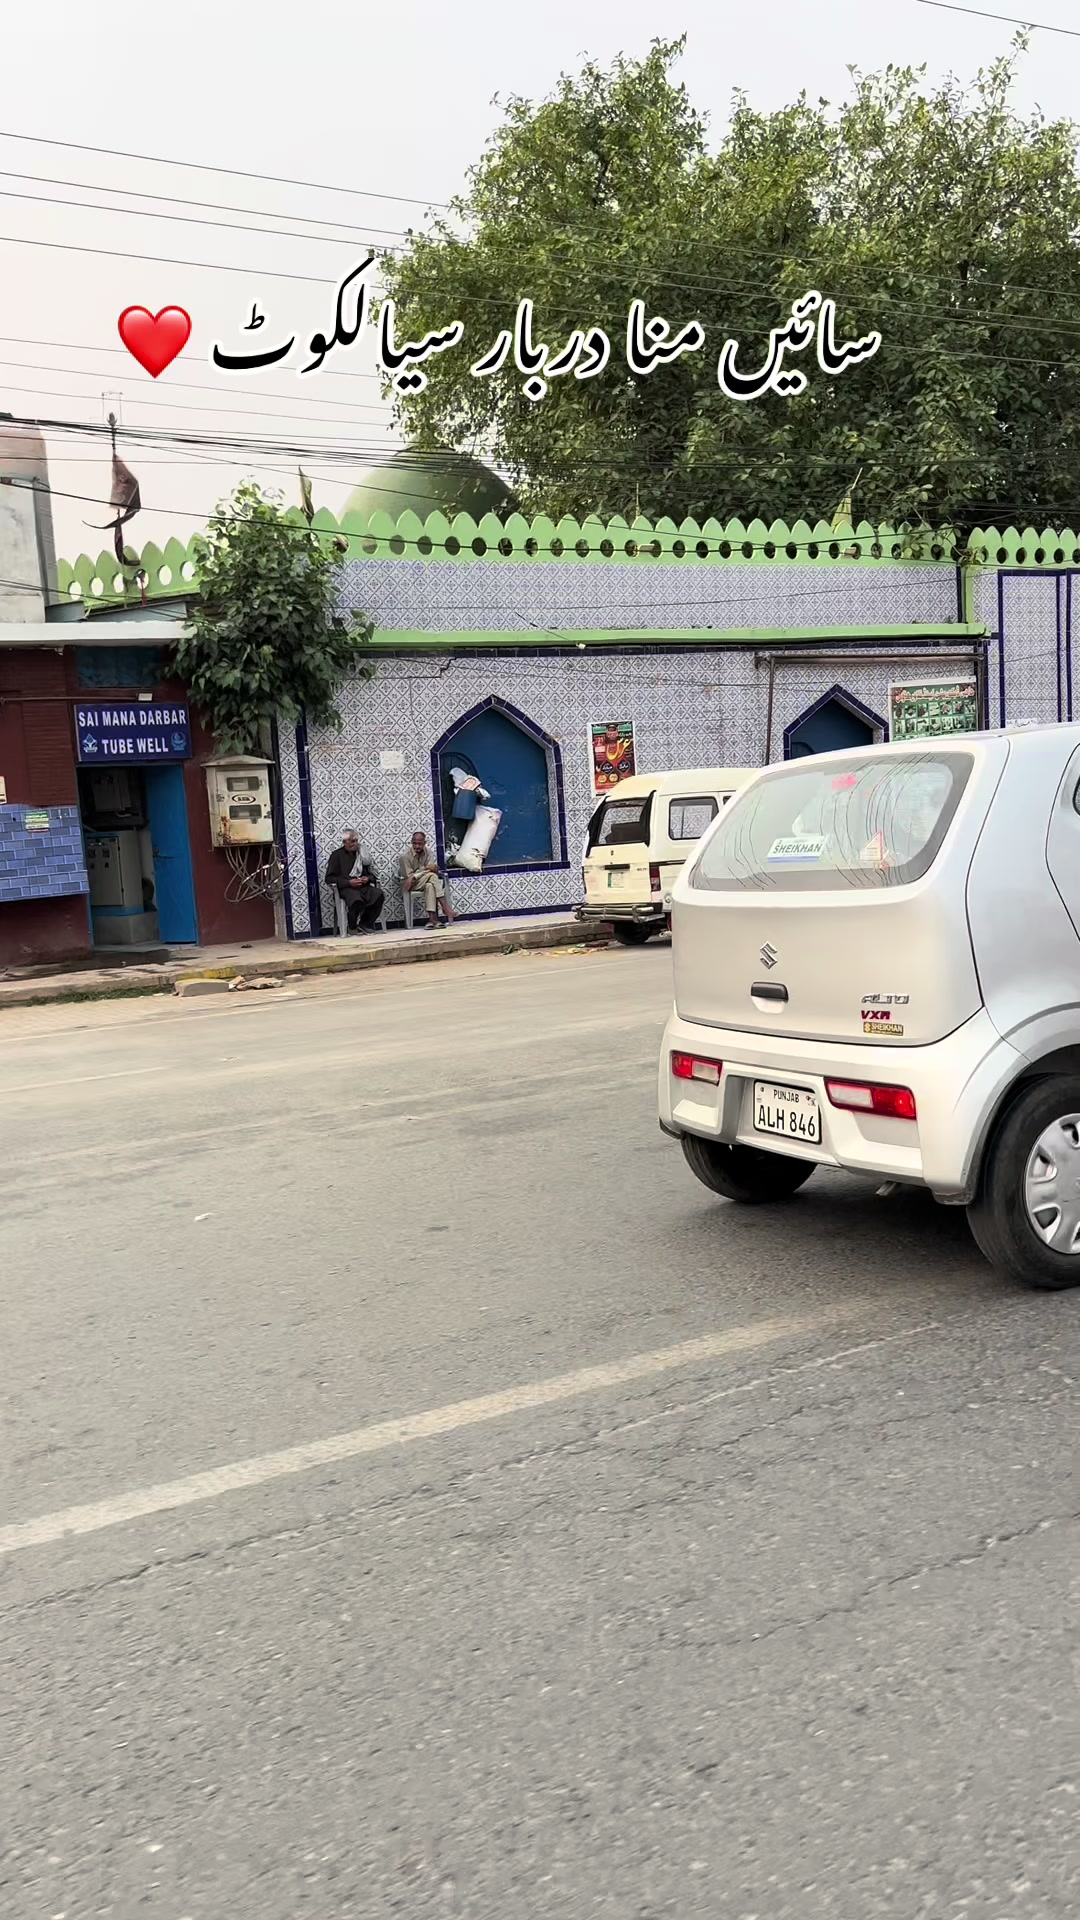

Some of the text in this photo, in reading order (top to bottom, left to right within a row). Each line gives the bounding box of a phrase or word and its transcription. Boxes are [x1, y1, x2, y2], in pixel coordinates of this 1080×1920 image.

[79, 709, 187, 727] SAI MANA DARBAR
[102, 737, 169, 754] TUBE WELL
[773, 843, 823, 854] SHEIKHAN
[861, 993, 910, 1005] ALTO
[860, 1010, 891, 1020] VXR
[871, 1022, 903, 1033] SHEIKHAN
[773, 1089, 800, 1103] PUNJAB
[758, 1104, 816, 1137] ALH 846
